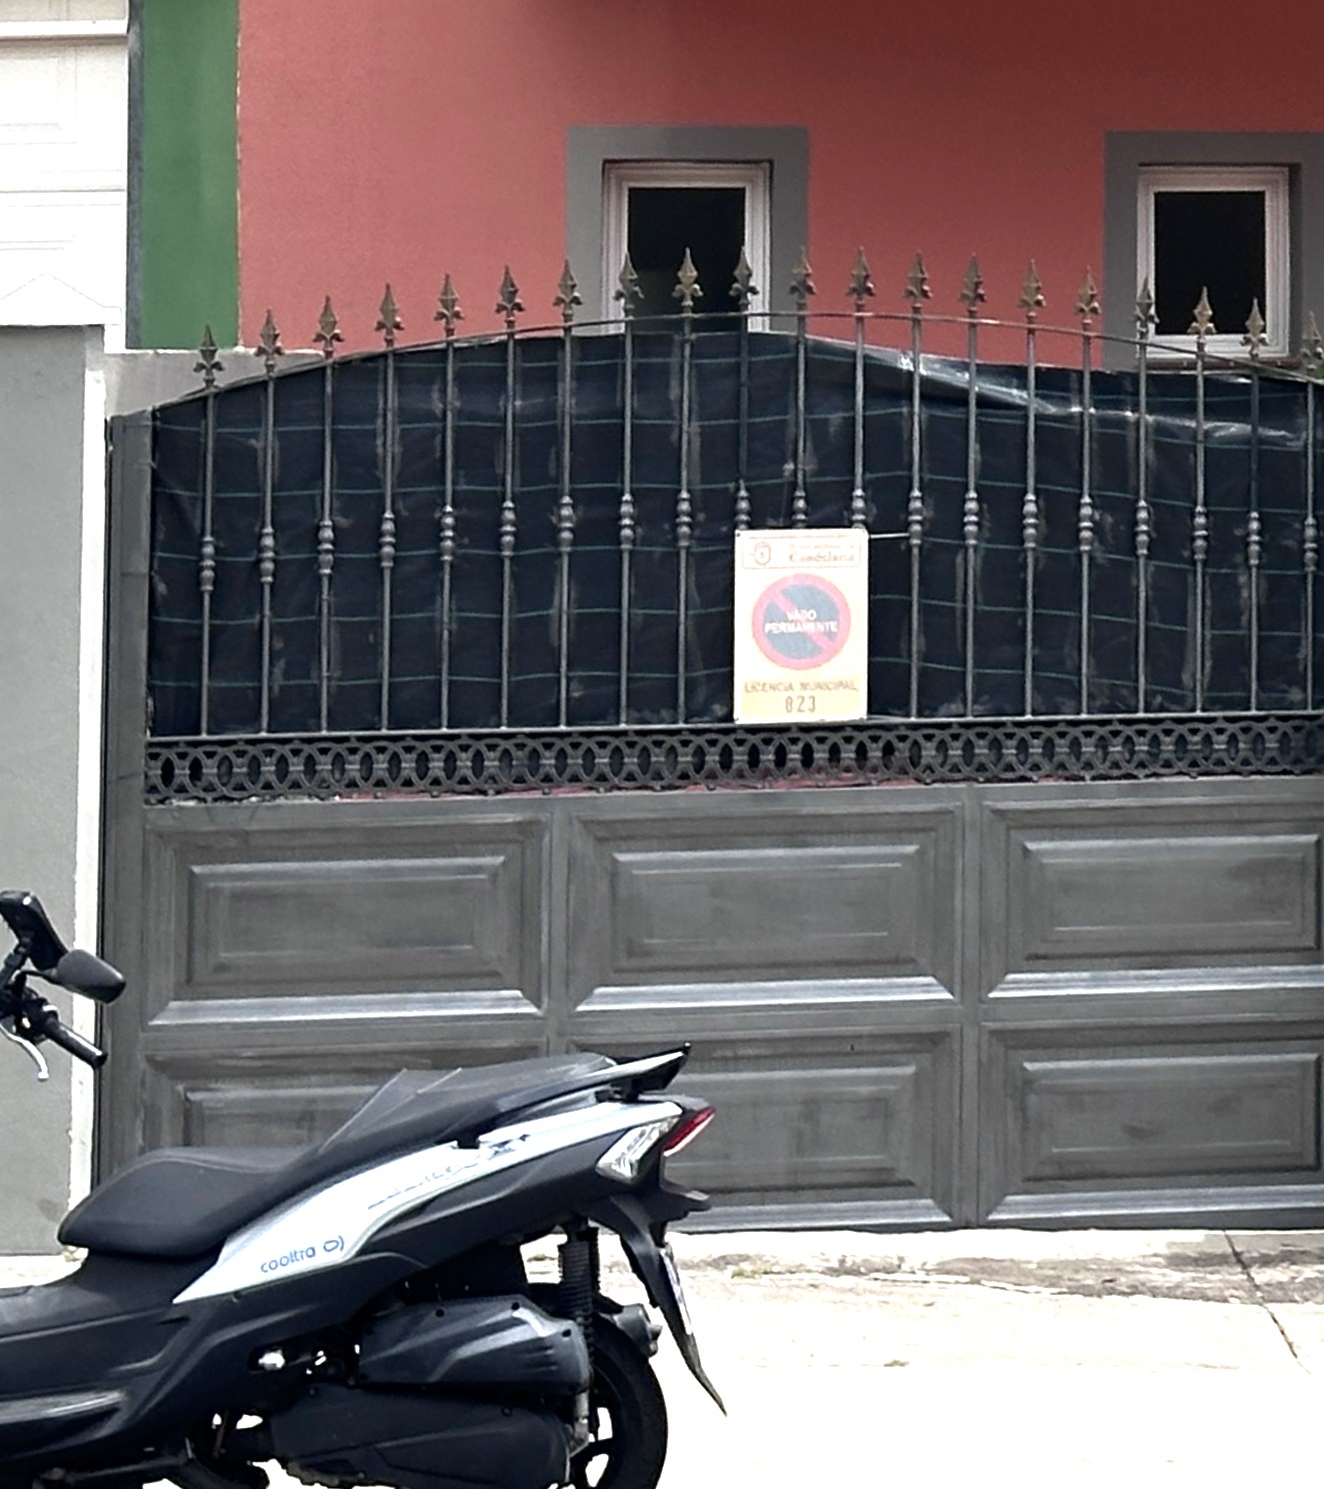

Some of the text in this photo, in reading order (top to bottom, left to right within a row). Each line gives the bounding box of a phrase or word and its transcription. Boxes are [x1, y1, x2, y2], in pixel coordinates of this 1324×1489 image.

[786, 609, 817, 621] VADO
[765, 621, 838, 633] PERMANENTE
[745, 680, 859, 693] LICENCIA MUNICIPAL
[785, 695, 816, 713] 823
[260, 1246, 316, 1273] cooltra
